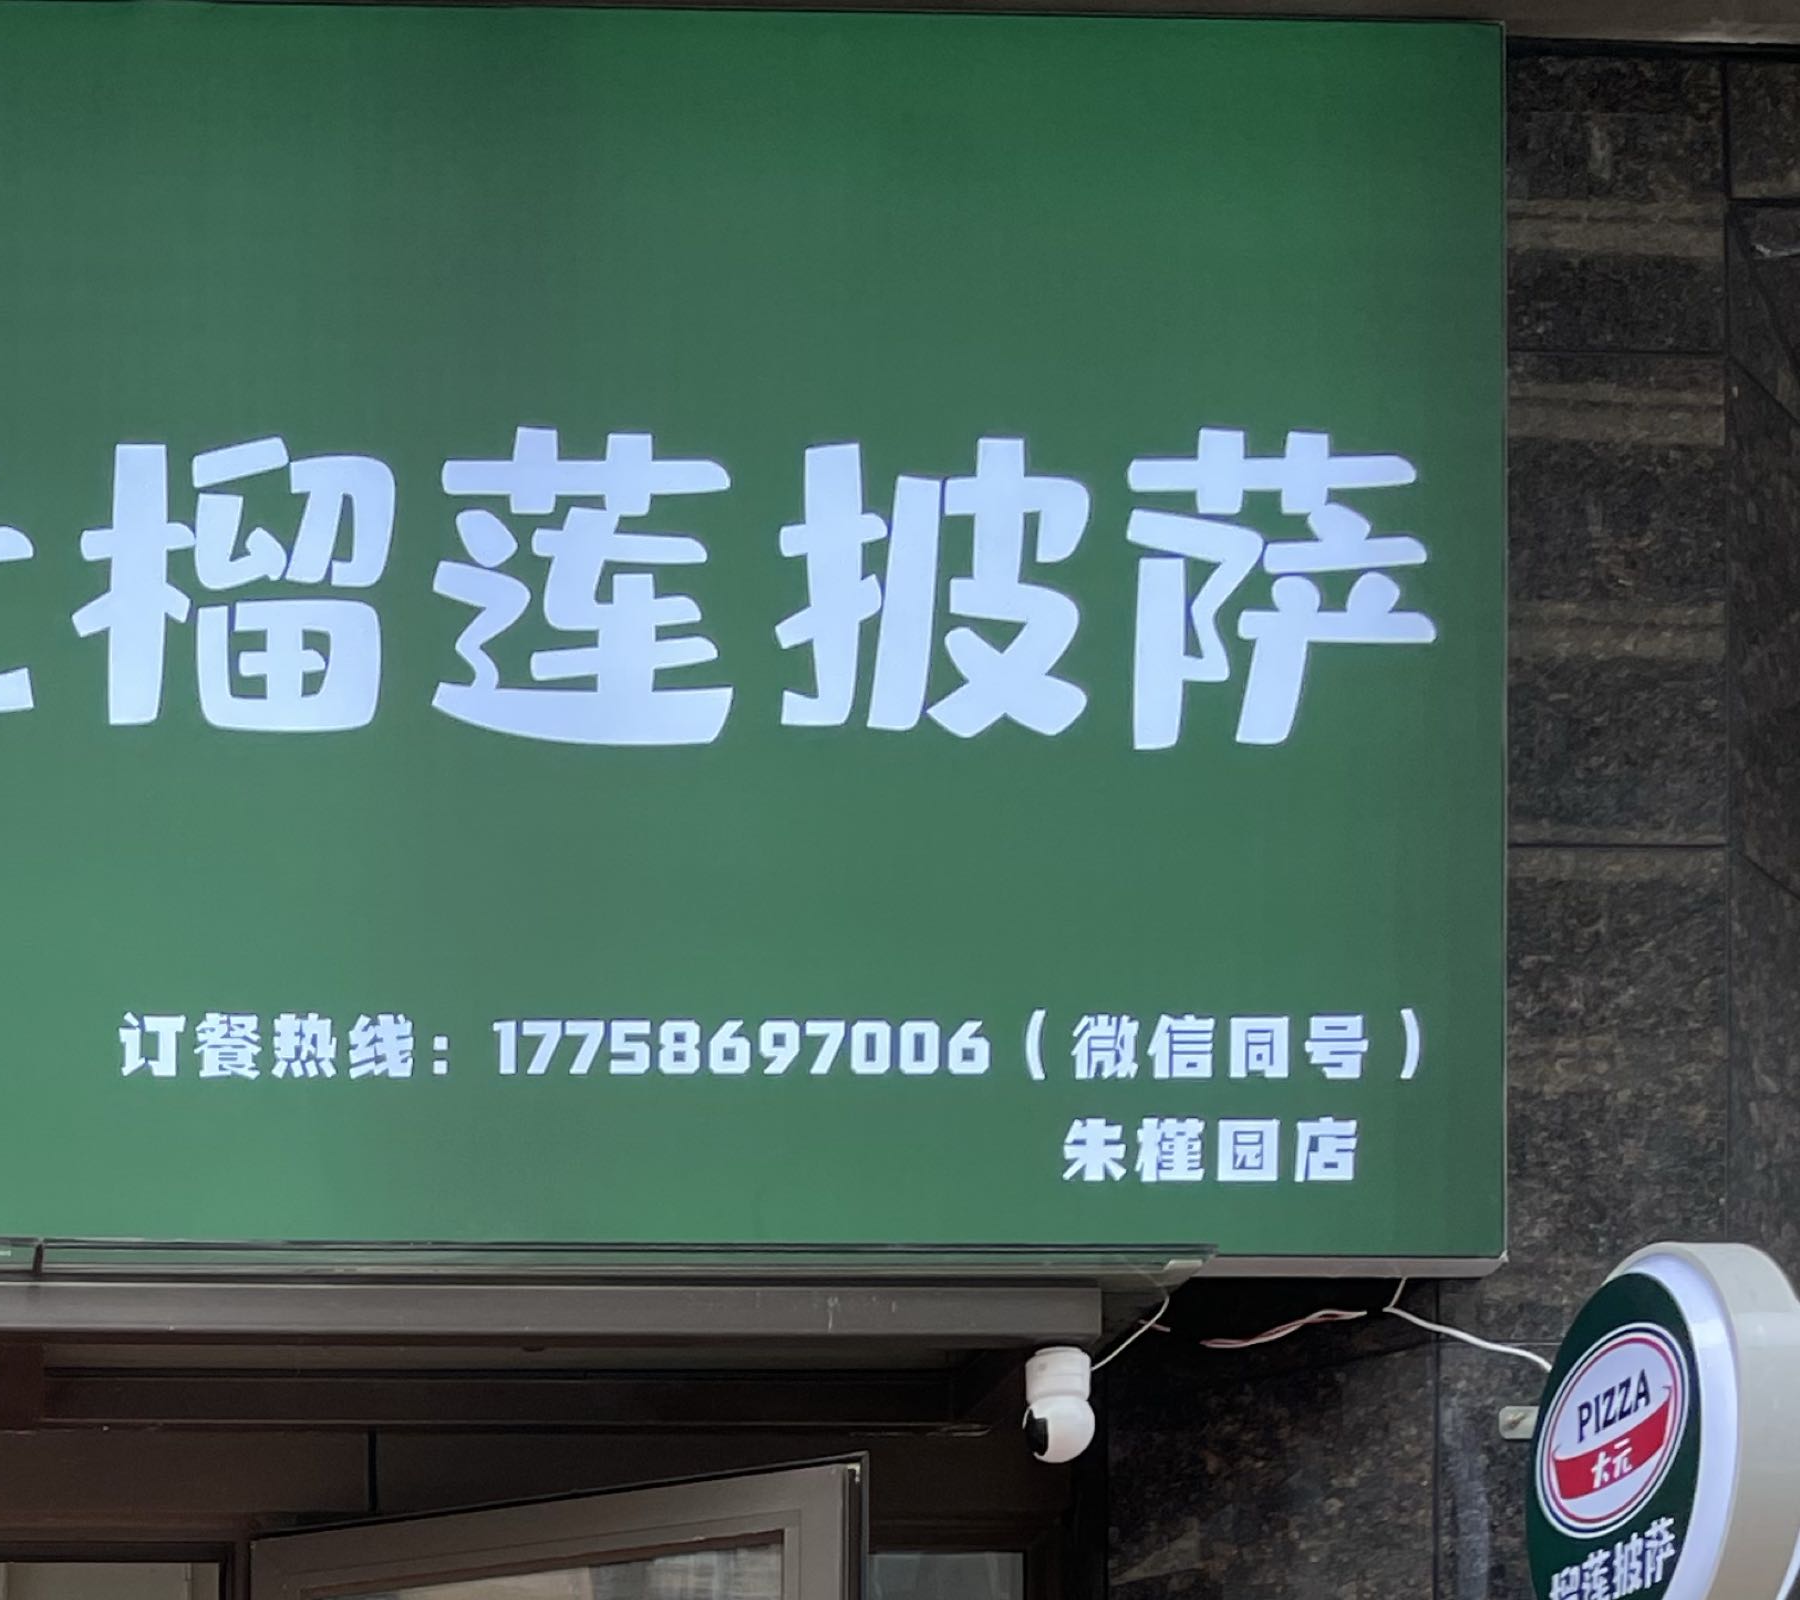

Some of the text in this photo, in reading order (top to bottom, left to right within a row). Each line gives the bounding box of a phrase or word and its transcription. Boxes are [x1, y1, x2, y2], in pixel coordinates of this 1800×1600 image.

[1061, 1117, 1360, 1184] 朱槿园店
[1576, 1368, 1652, 1444] PIZZA
[1590, 1438, 1633, 1490] 大元
